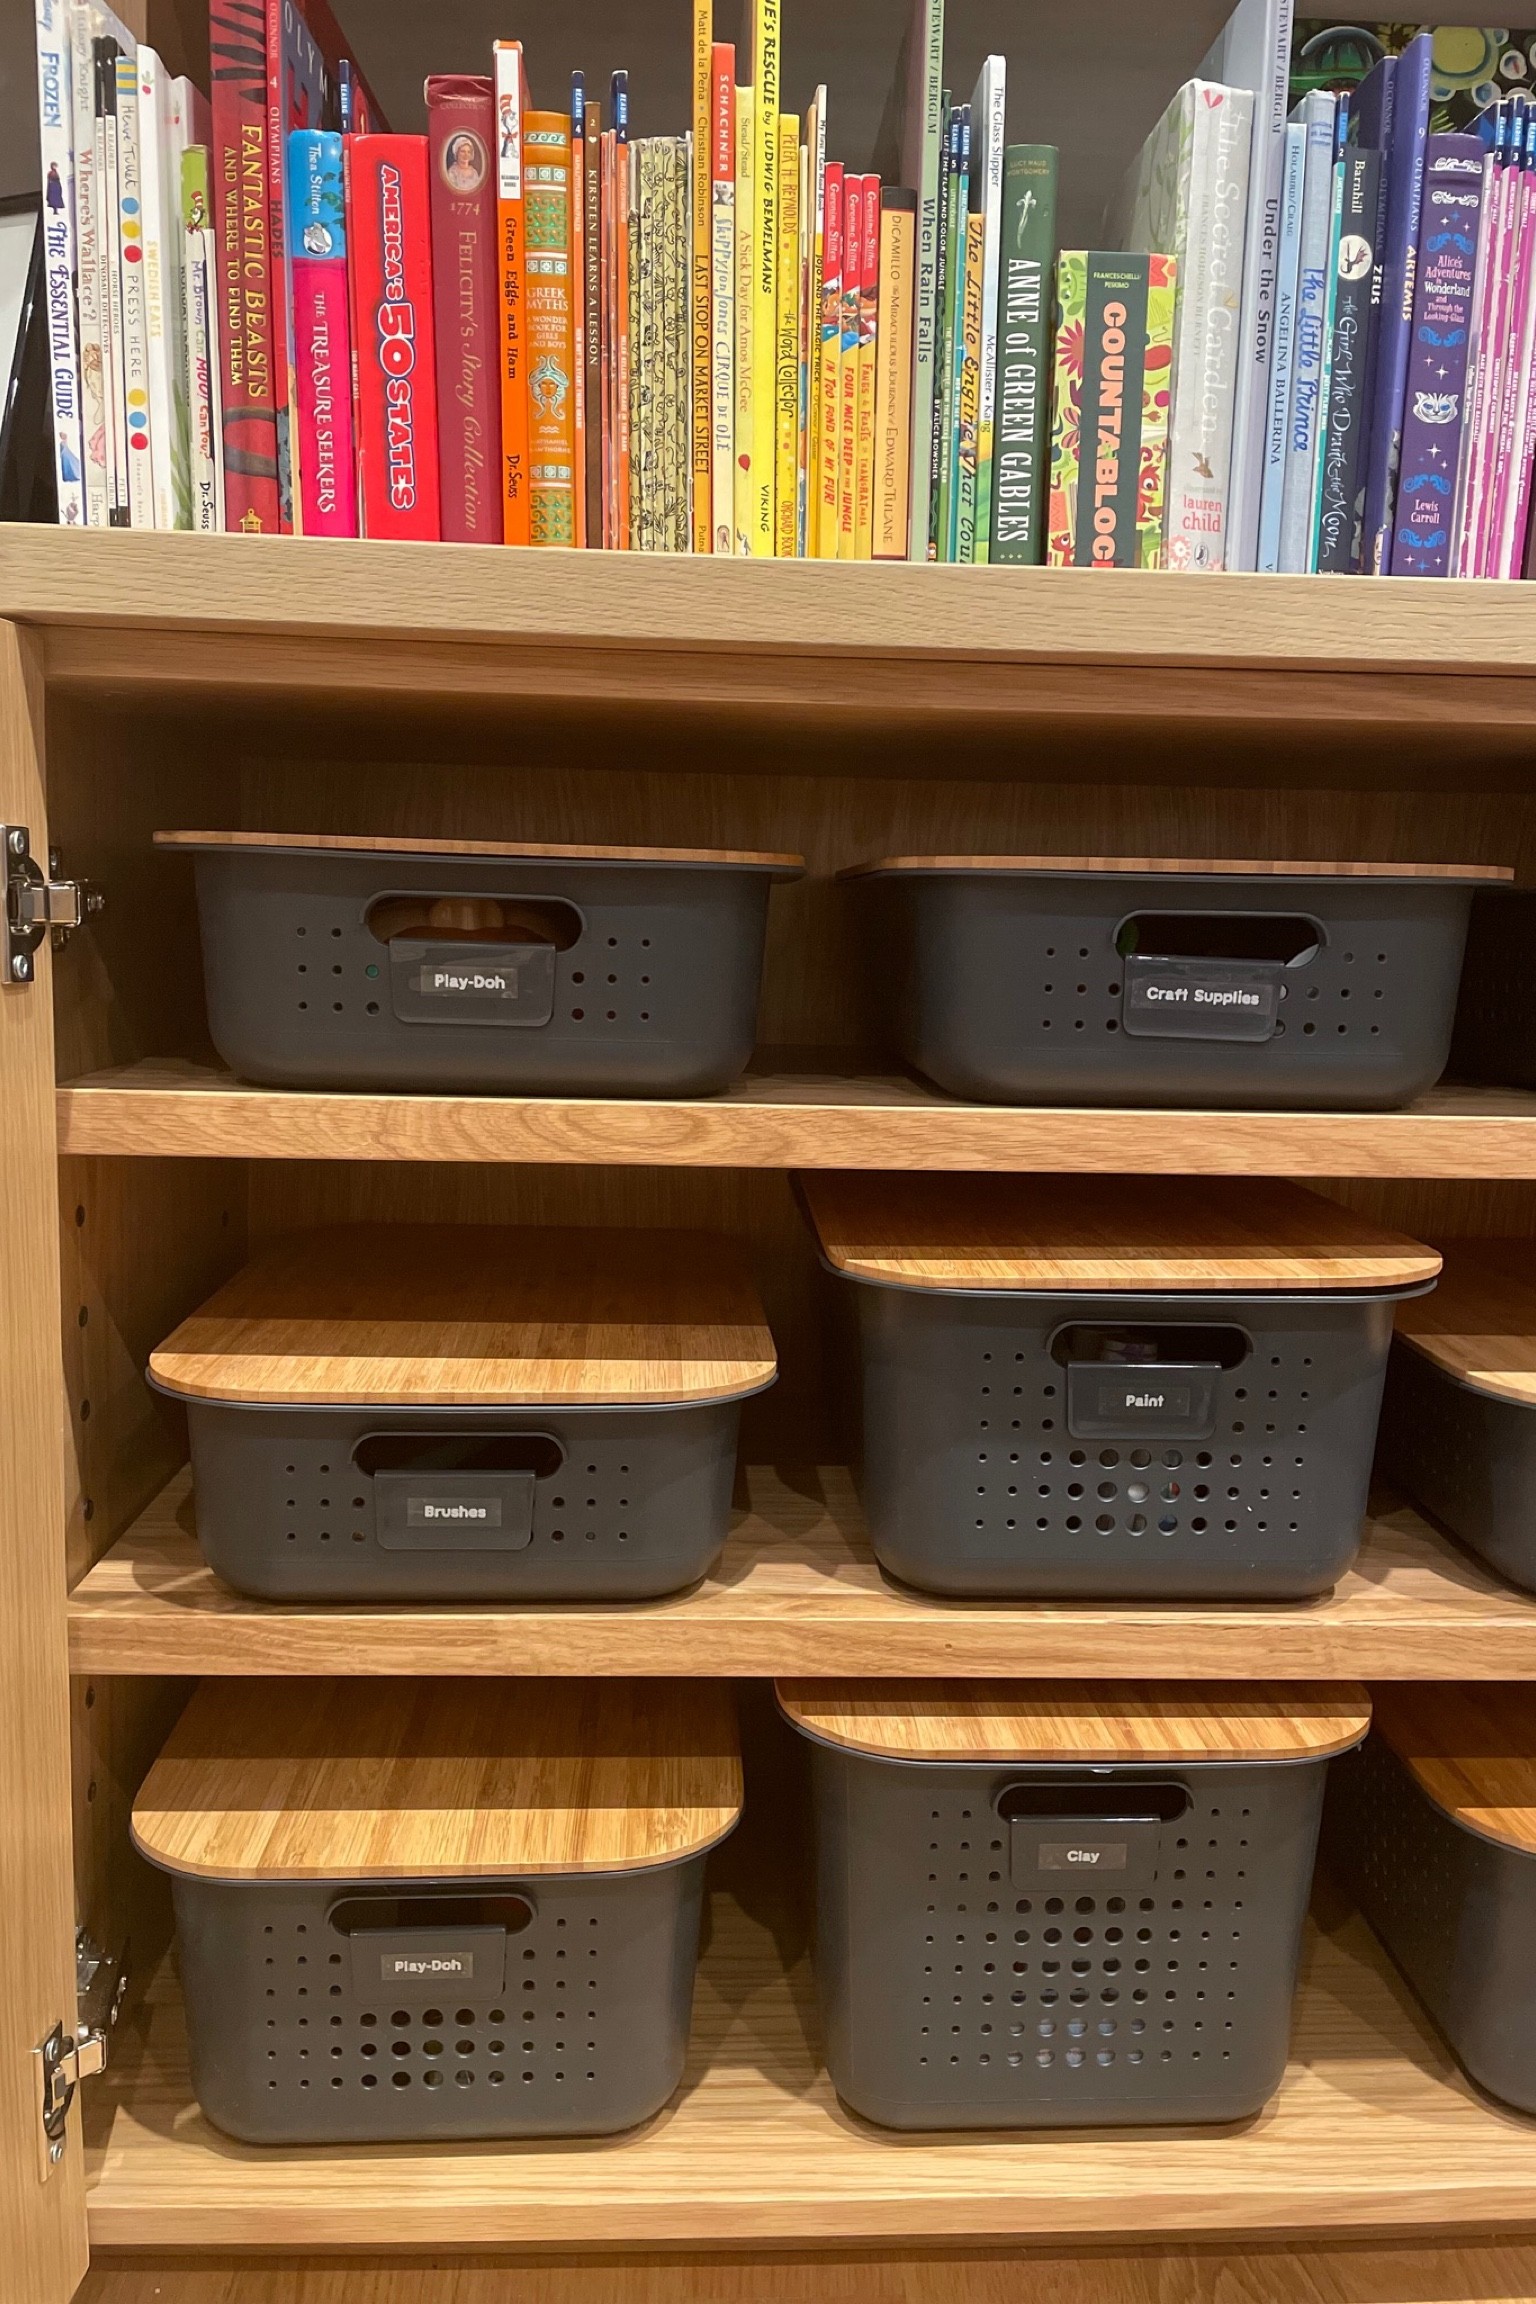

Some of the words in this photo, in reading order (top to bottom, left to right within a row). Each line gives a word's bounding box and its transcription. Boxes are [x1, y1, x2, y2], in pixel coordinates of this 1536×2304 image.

[699, 10, 708, 35] Matt
[699, 38, 707, 52] de
[699, 56, 707, 67] la
[41, 51, 62, 128] FROZEN
[698, 72, 708, 100] Peña
[763, 37, 776, 105] RESCUE
[928, 75, 939, 134] BERGUM
[994, 86, 1004, 107] The
[1272, 75, 1285, 134] BERGUM
[575, 125, 581, 134] 4
[589, 118, 596, 127] 2
[620, 130, 626, 139] 4
[720, 74, 730, 171] SCHACHNER
[762, 111, 773, 125] by
[992, 111, 1003, 146] Glass
[1418, 127, 1425, 139] 9
[270, 106, 281, 184] OLYMPIANS
[309, 143, 322, 172] Thea
[698, 116, 708, 171] Christian
[741, 118, 750, 179] Stead/Stead
[763, 133, 774, 192] LUDWIG
[782, 134, 797, 164] PETER
[224, 147, 238, 182] AND
[951, 160, 957, 169] 5
[962, 162, 968, 170] 2
[990, 148, 1002, 187] Slipper
[79, 148, 93, 226] Where's
[242, 124, 265, 279] FANTASTIC
[310, 174, 323, 215] Stilton
[588, 169, 597, 236] KIRSTEN
[698, 173, 708, 226] Robinson
[1351, 160, 1365, 214] Barnhill
[1411, 157, 1423, 231] OLYMPIANS
[225, 189, 239, 252] WHERE
[449, 202, 481, 216] 1774
[782, 184, 797, 235] REYNOLDS
[922, 198, 935, 253] When
[47, 221, 68, 258] THE
[270, 200, 283, 259] HADES
[380, 163, 404, 301] AMERICA'S
[505, 217, 518, 262] Green
[740, 231, 751, 241] A
[762, 198, 774, 294] BEMELMANS
[968, 221, 982, 263] The
[1262, 199, 1278, 260] Under
[147, 240, 160, 300] SWEDISH
[227, 259, 240, 280] TO
[588, 237, 598, 292] LEARNS
[695, 254, 708, 289] LAST
[740, 244, 752, 270] Sick
[1425, 266, 1471, 281] Adventures
[1438, 255, 1463, 268] Alice's
[111, 270, 119, 299] HORSE
[127, 275, 139, 325] PRESS
[458, 231, 478, 338] FELICITY'S
[505, 270, 520, 306] Eggs
[526, 287, 566, 299] GREEK
[588, 298, 597, 306] A
[739, 273, 752, 301] Day
[920, 262, 933, 307] Rain
[1007, 259, 1041, 323] ANNE
[1259, 269, 1274, 306] the
[1303, 266, 1324, 301] The
[1371, 264, 1383, 305] ZEUS
[1402, 245, 1417, 322] ARTEMIS
[1424, 281, 1471, 297] Wonderland
[1436, 295, 1447, 303] and
[48, 264, 71, 360] ESSENTIAL
[113, 301, 121, 334] HEROES
[150, 302, 161, 337] EATS
[192, 284, 205, 325] Brown
[228, 286, 241, 330] FIND
[314, 291, 326, 318] THE
[526, 300, 569, 310] MYTHS
[695, 294, 709, 328] STOP
[740, 303, 753, 323] for
[966, 270, 981, 344] Little
[1427, 302, 1454, 313] Through
[1454, 303, 1464, 313] the
[195, 330, 206, 354] Can
[245, 288, 268, 398] BEASTS
[376, 302, 415, 378] 50
[507, 313, 518, 341] and
[589, 312, 598, 366] LESSON
[695, 335, 709, 357] ON
[739, 328, 752, 360] Amos
[780, 328, 797, 362] Word
[919, 317, 931, 363] Falls
[1005, 332, 1037, 357] of
[1255, 310, 1270, 363] Snow
[1276, 292, 1289, 372] ANGELINA
[1300, 307, 1322, 368] Little
[130, 335, 143, 377] HERE
[230, 335, 243, 386] THEM
[311, 321, 335, 425] TREASURE
[507, 347, 518, 380] Ham
[713, 341, 730, 399] CIRQUE
[985, 335, 996, 396] McAllister
[1201, 306, 1232, 438] Garden
[54, 368, 74, 419] GUIDE
[455, 345, 483, 409] Story
[695, 364, 710, 421] MARKET
[739, 366, 752, 413] McGee
[778, 364, 798, 418] Collector
[824, 377, 836, 399] TOO
[844, 367, 854, 398] FOUR
[861, 363, 873, 394] FANGS
[824, 404, 835, 433] FOND
[843, 402, 854, 433] MICE
[960, 356, 979, 443] Engine
[1001, 363, 1036, 442] GREEN
[1294, 378, 1317, 452] Prince
[981, 405, 994, 433] Kang
[1271, 379, 1285, 465] BALLERINA
[386, 378, 416, 509] STATES
[507, 453, 520, 471] Dr.
[695, 426, 710, 475] STREET
[843, 438, 853, 466] DEEP
[885, 427, 898, 487] EDWARD
[200, 481, 210, 499] Dr.
[315, 430, 336, 513] SEEKERS
[462, 414, 484, 530] Collection
[508, 471, 523, 498] Seuss
[760, 484, 770, 533] VIKING
[823, 476, 834, 506] FUR!
[997, 452, 1032, 542] GABLES
[1183, 495, 1223, 512] lauren
[1415, 499, 1439, 512] Lewis
[201, 501, 213, 530] Seuss
[842, 490, 853, 534] JUNGLE
[883, 490, 896, 543] TULANE
[1183, 513, 1222, 533] child
[1411, 512, 1440, 524] Carroll
[434, 974, 506, 991] Play-Doh
[1146, 986, 1188, 1002] Craft
[1194, 989, 1260, 1006] Supplies
[1125, 1394, 1164, 1407] Paint
[424, 1505, 487, 1518] Brushes
[1066, 1850, 1100, 1864] Clay
[394, 1959, 462, 1974] Play-Doh
